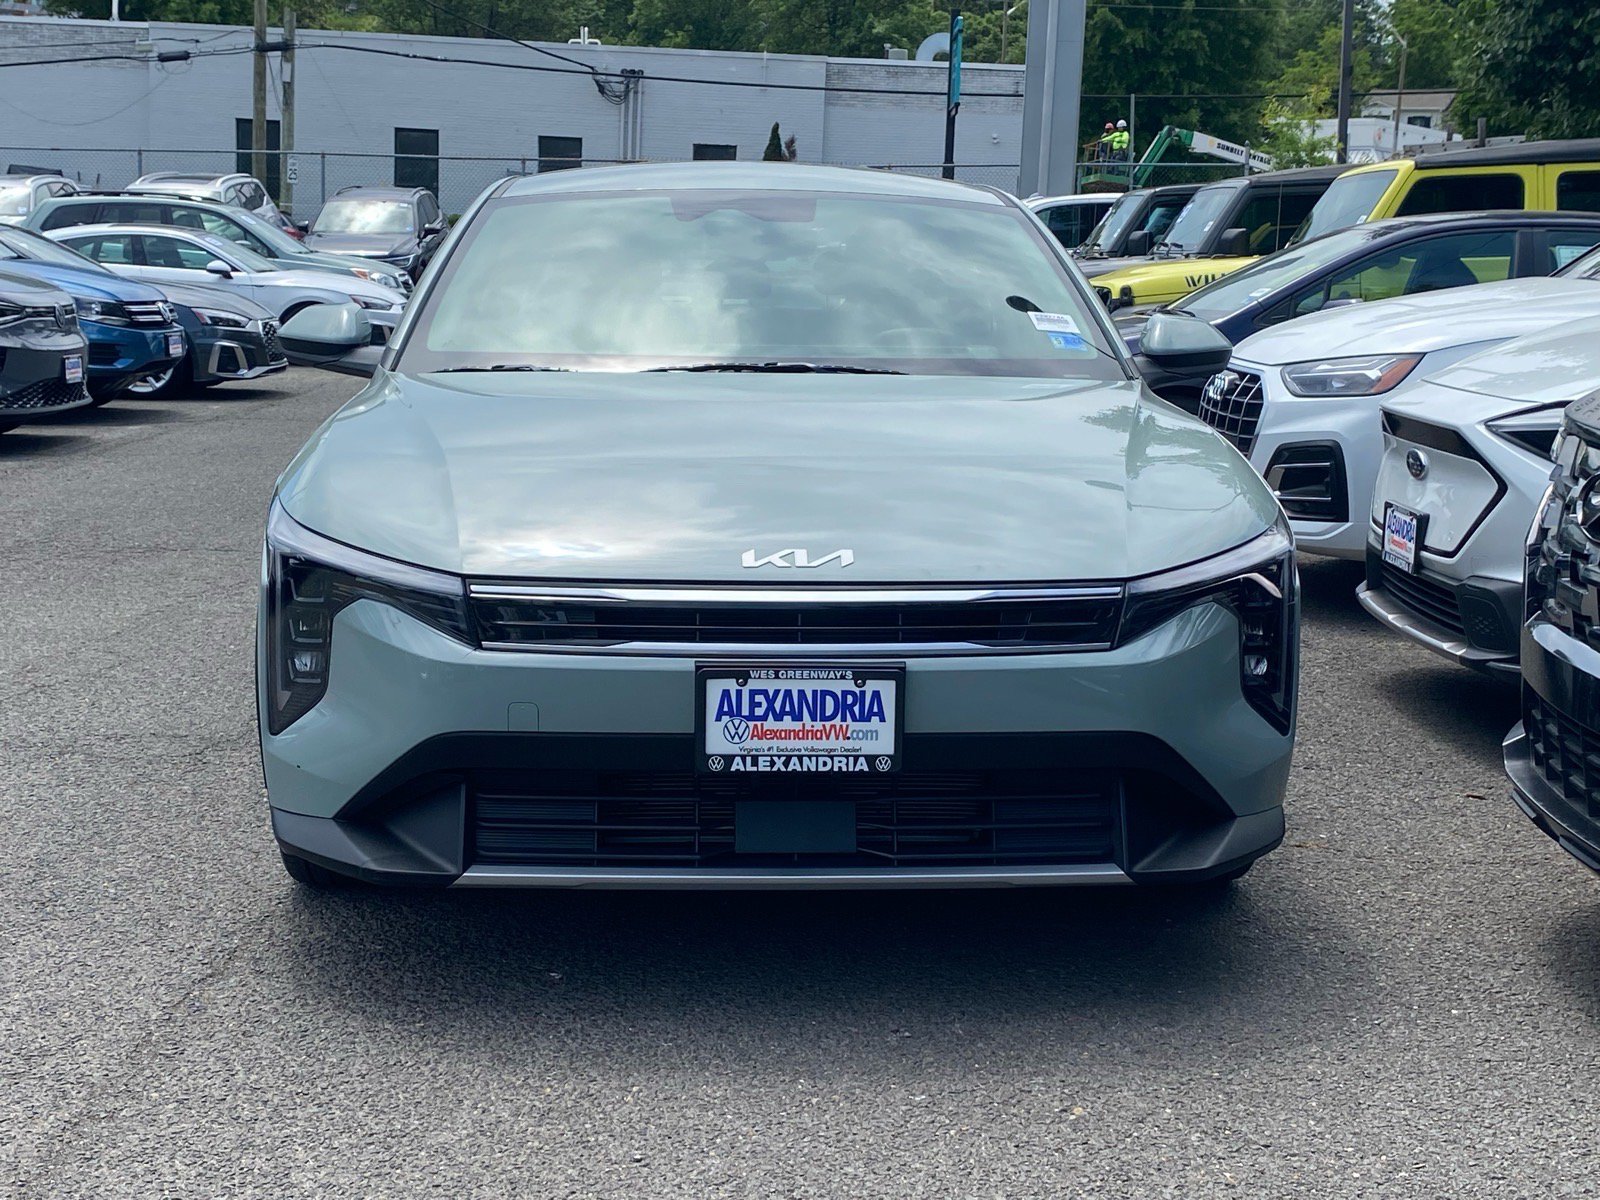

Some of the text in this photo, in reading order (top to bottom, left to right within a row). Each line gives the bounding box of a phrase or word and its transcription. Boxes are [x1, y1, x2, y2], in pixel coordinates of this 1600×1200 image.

[1216, 142, 1244, 157] SUNBELT
[288, 168, 298, 180] 25
[741, 548, 854, 569] KIA
[749, 669, 853, 680] WES GREENWAY'S
[714, 688, 887, 723] ALEXANDRIA
[750, 722, 879, 742] AlexandriaVW.com
[738, 746, 766, 755] Virginia's
[803, 746, 839, 755] Volkswagen
[730, 756, 870, 772] ALEXANDRIA
